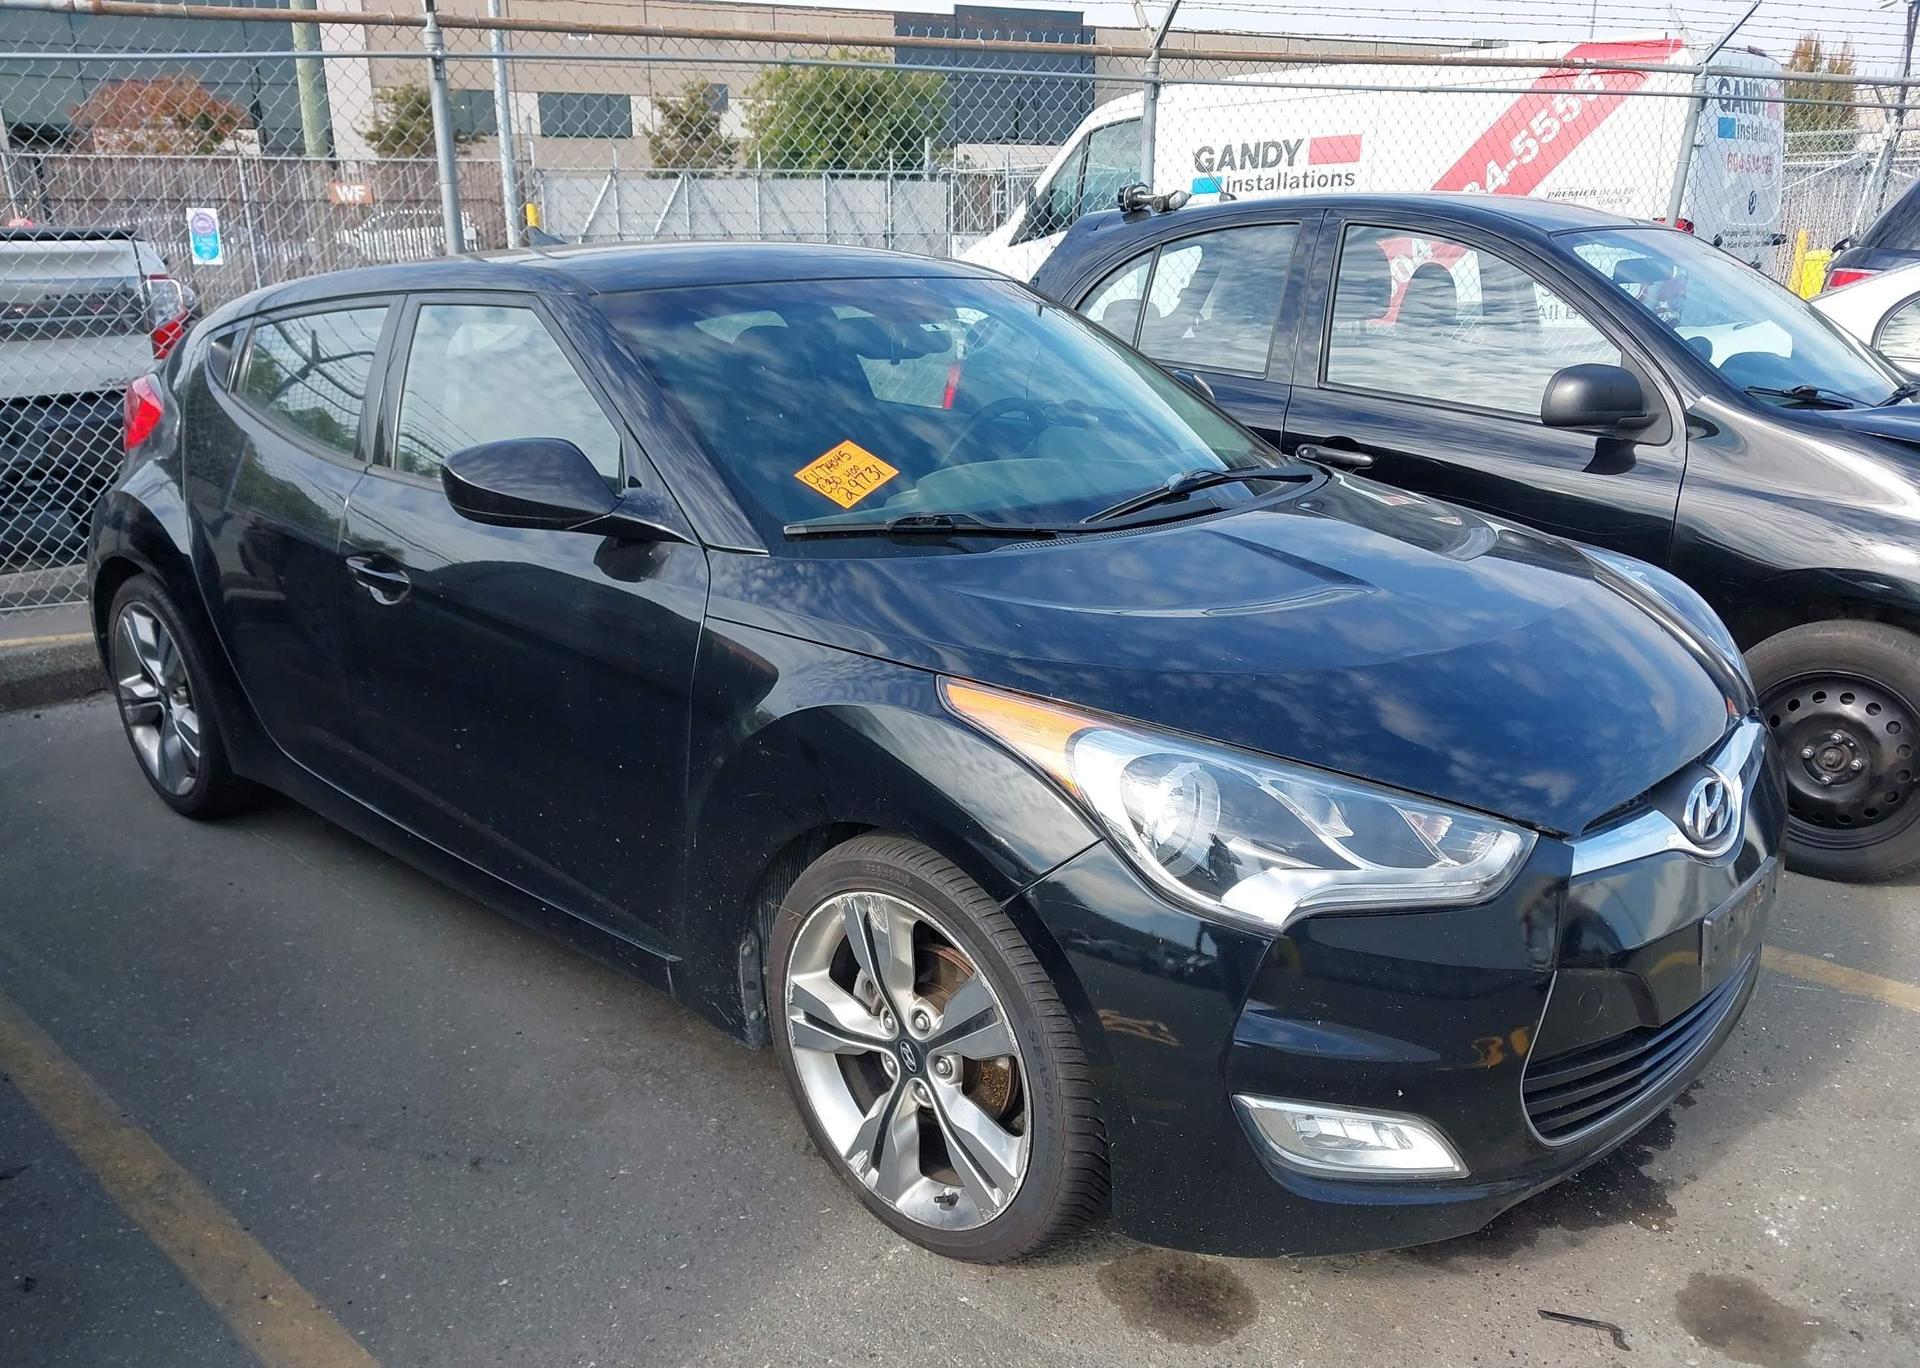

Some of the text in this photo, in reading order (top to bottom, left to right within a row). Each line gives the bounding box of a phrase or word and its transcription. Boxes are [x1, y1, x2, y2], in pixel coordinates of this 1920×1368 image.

[1717, 78, 1768, 116] GANDY
[1194, 138, 1304, 173] GANDY
[336, 185, 366, 202] WF
[1226, 170, 1355, 193] installations
[1547, 189, 1597, 199] PREMIER
[837, 464, 886, 501] 29731
